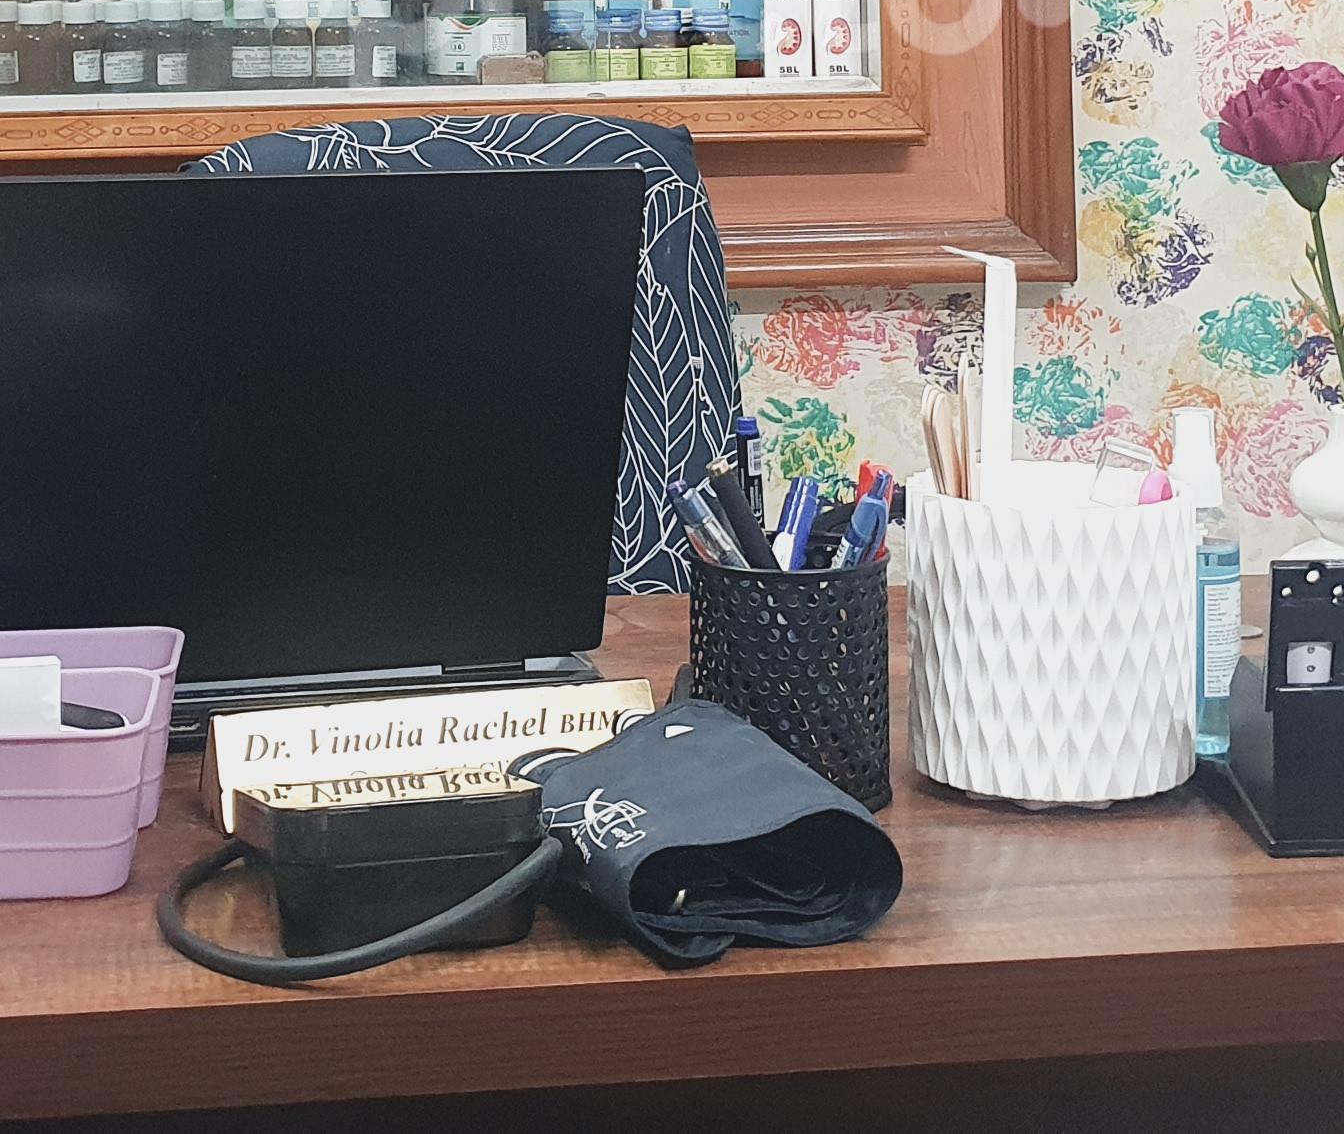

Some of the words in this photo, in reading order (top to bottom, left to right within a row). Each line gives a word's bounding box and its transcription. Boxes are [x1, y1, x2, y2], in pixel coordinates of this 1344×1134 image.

[779, 66, 800, 74] SBL
[829, 65, 850, 73] SBL
[244, 733, 292, 763] Dr.
[309, 718, 424, 758] Vinolia
[437, 707, 547, 746] Rachel
